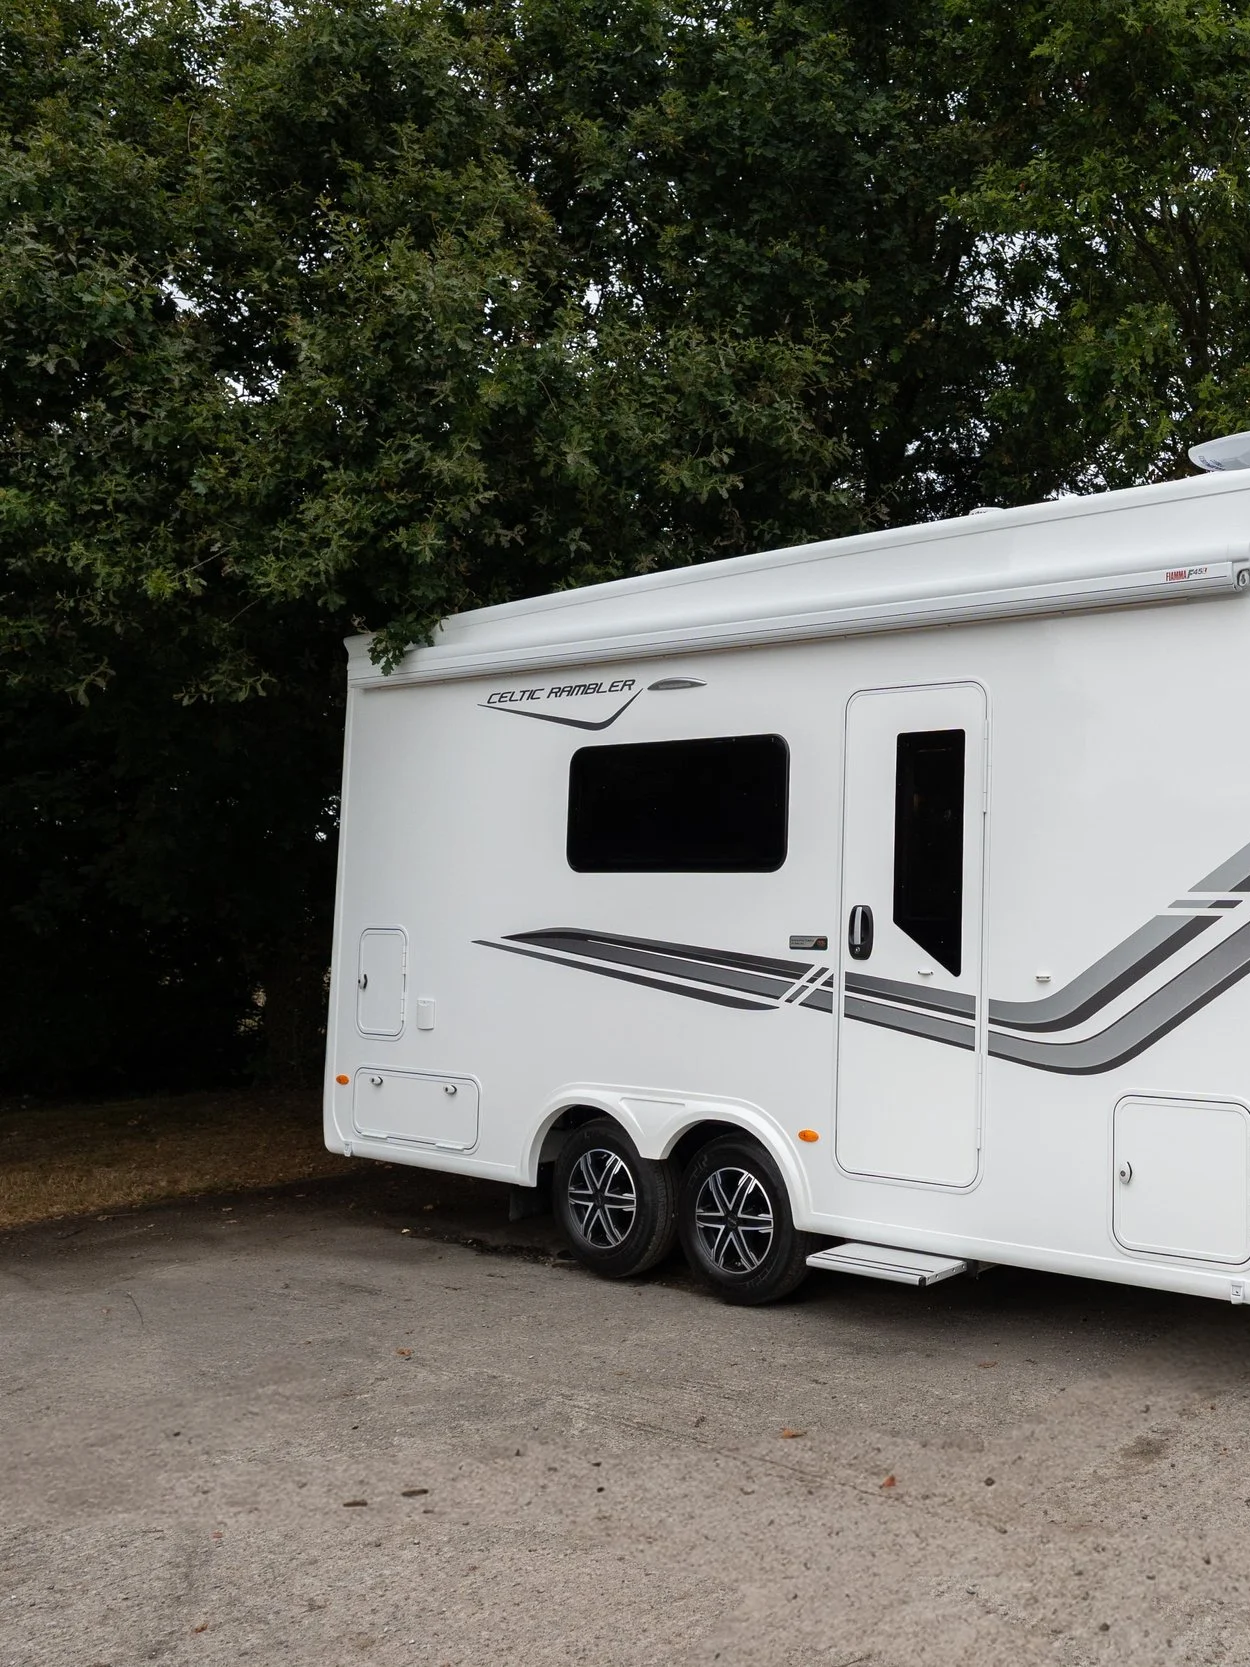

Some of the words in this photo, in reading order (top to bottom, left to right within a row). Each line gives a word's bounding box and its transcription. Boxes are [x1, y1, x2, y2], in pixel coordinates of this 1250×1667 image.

[1165, 570, 1187, 581] FIAMMA
[487, 688, 545, 705] CELTIC
[547, 679, 636, 699] RAMBLER
